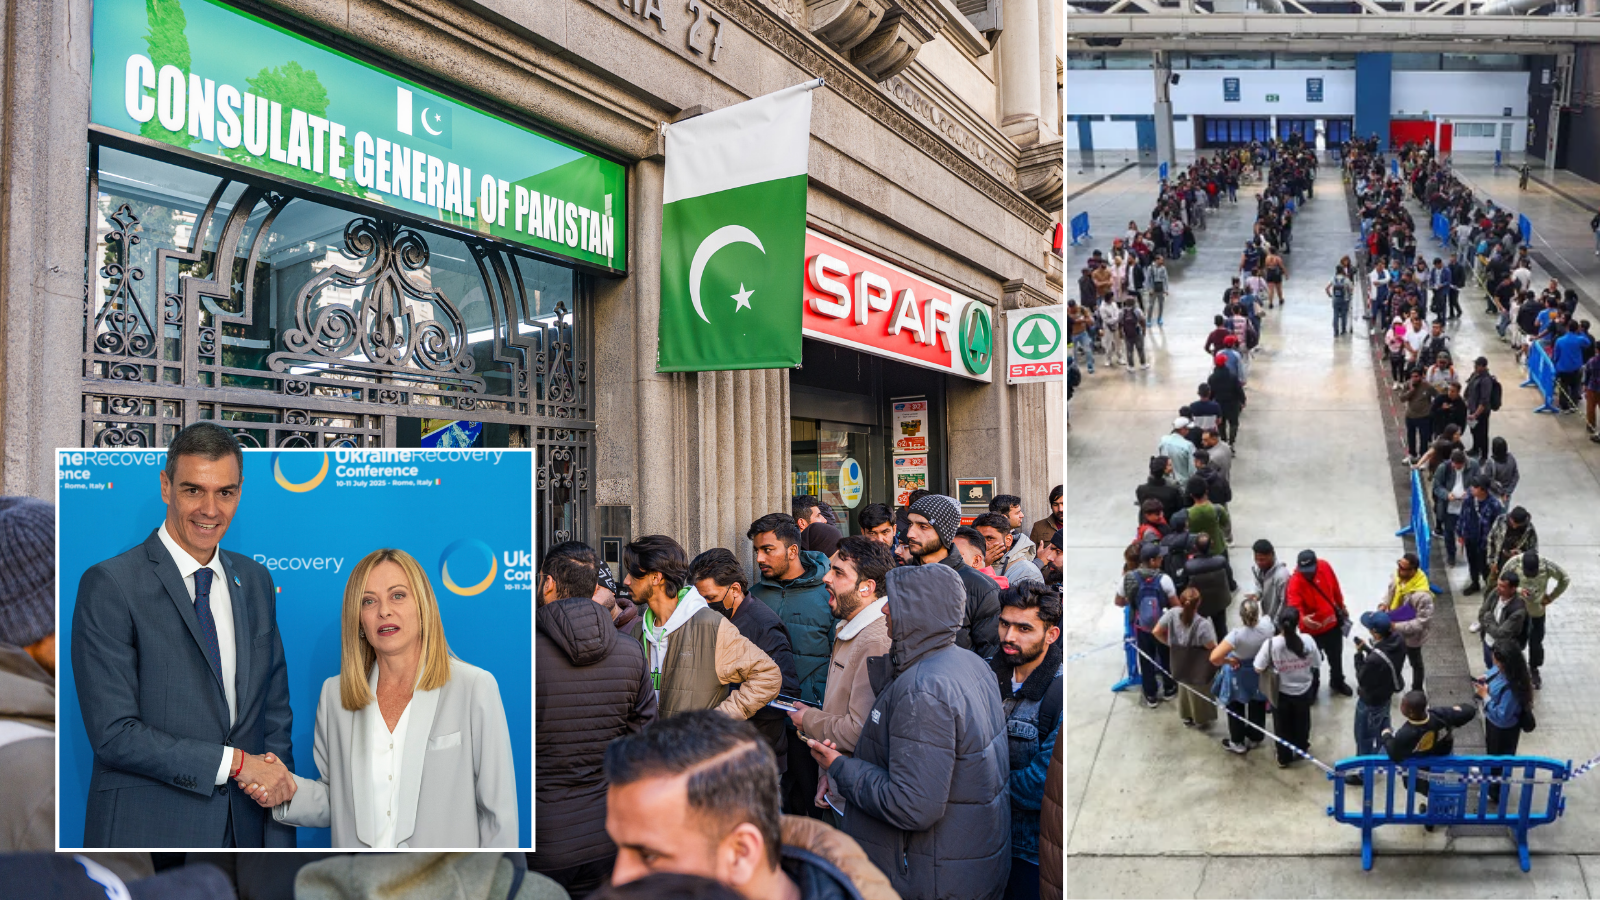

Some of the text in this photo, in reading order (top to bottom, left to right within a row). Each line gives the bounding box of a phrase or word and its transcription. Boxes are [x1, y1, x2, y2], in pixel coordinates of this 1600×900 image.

[687, 0, 724, 62] 27
[125, 54, 615, 259] CONSULATE GENERAL OF PAKISTAN
[808, 253, 954, 353] SPAR
[1011, 363, 1062, 376] SPAR
[59, 451, 168, 466] neRecover
[335, 465, 419, 478] Conference
[89, 482, 105, 490] Italy
[353, 480, 368, 488] July
[392, 479, 416, 487] Rome,
[417, 479, 433, 487] Italy
[504, 583, 520, 591] 10-11
